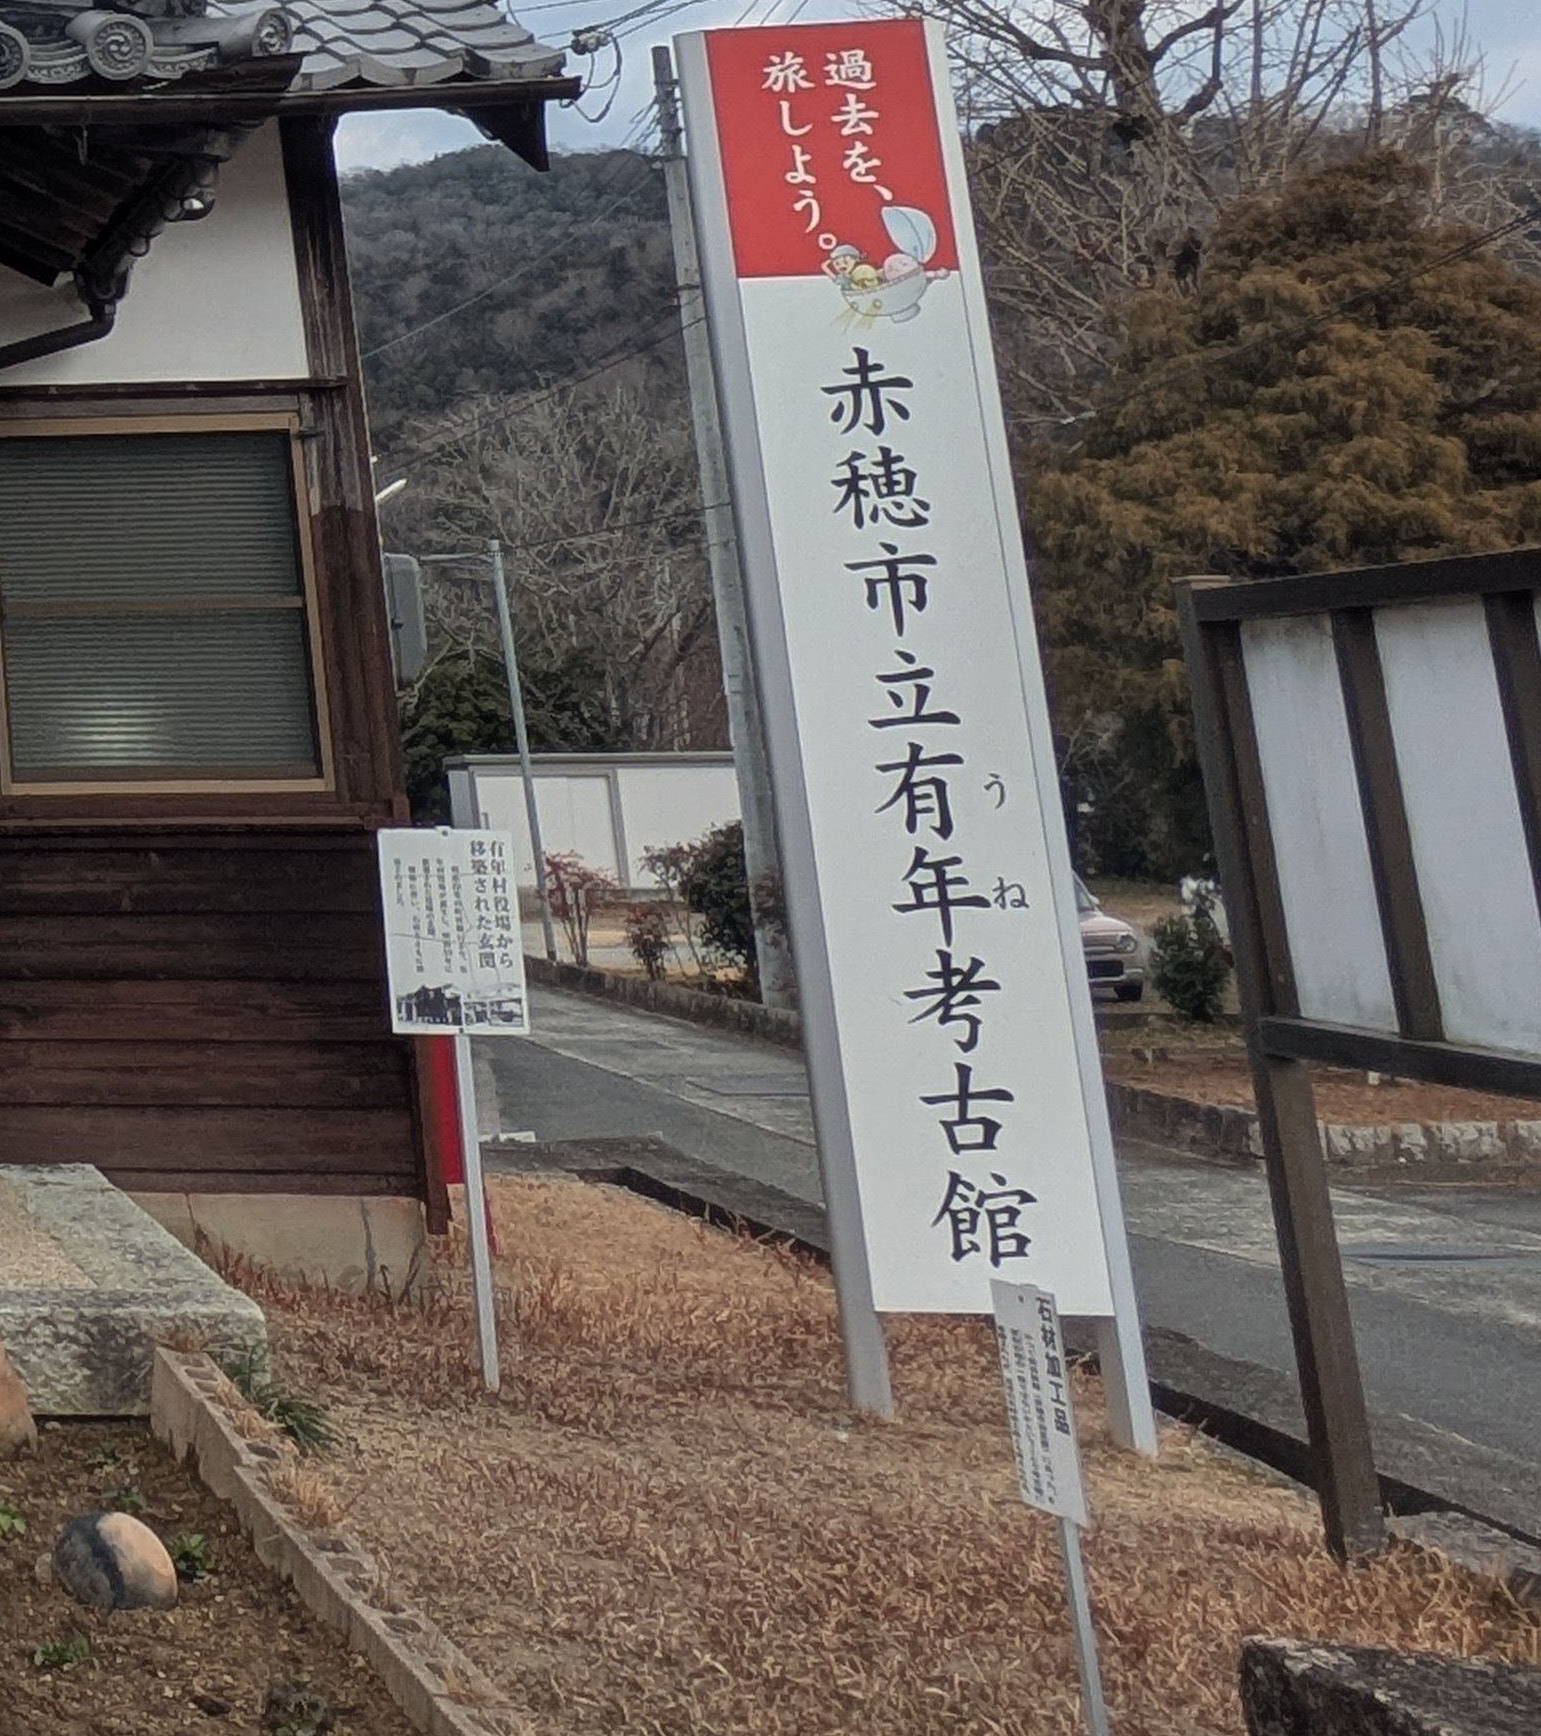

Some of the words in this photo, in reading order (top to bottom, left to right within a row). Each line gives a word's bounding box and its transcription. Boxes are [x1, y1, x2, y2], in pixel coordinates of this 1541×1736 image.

[761, 53, 837, 251] 旅しよう。
[824, 48, 893, 202] 過去を、
[819, 347, 1039, 1267] 赤穂市立有年考古館
[470, 840, 496, 968] 移築された玄関
[490, 840, 513, 968] 有年村役場から
[1035, 1296, 1071, 1437] 石材加工品
